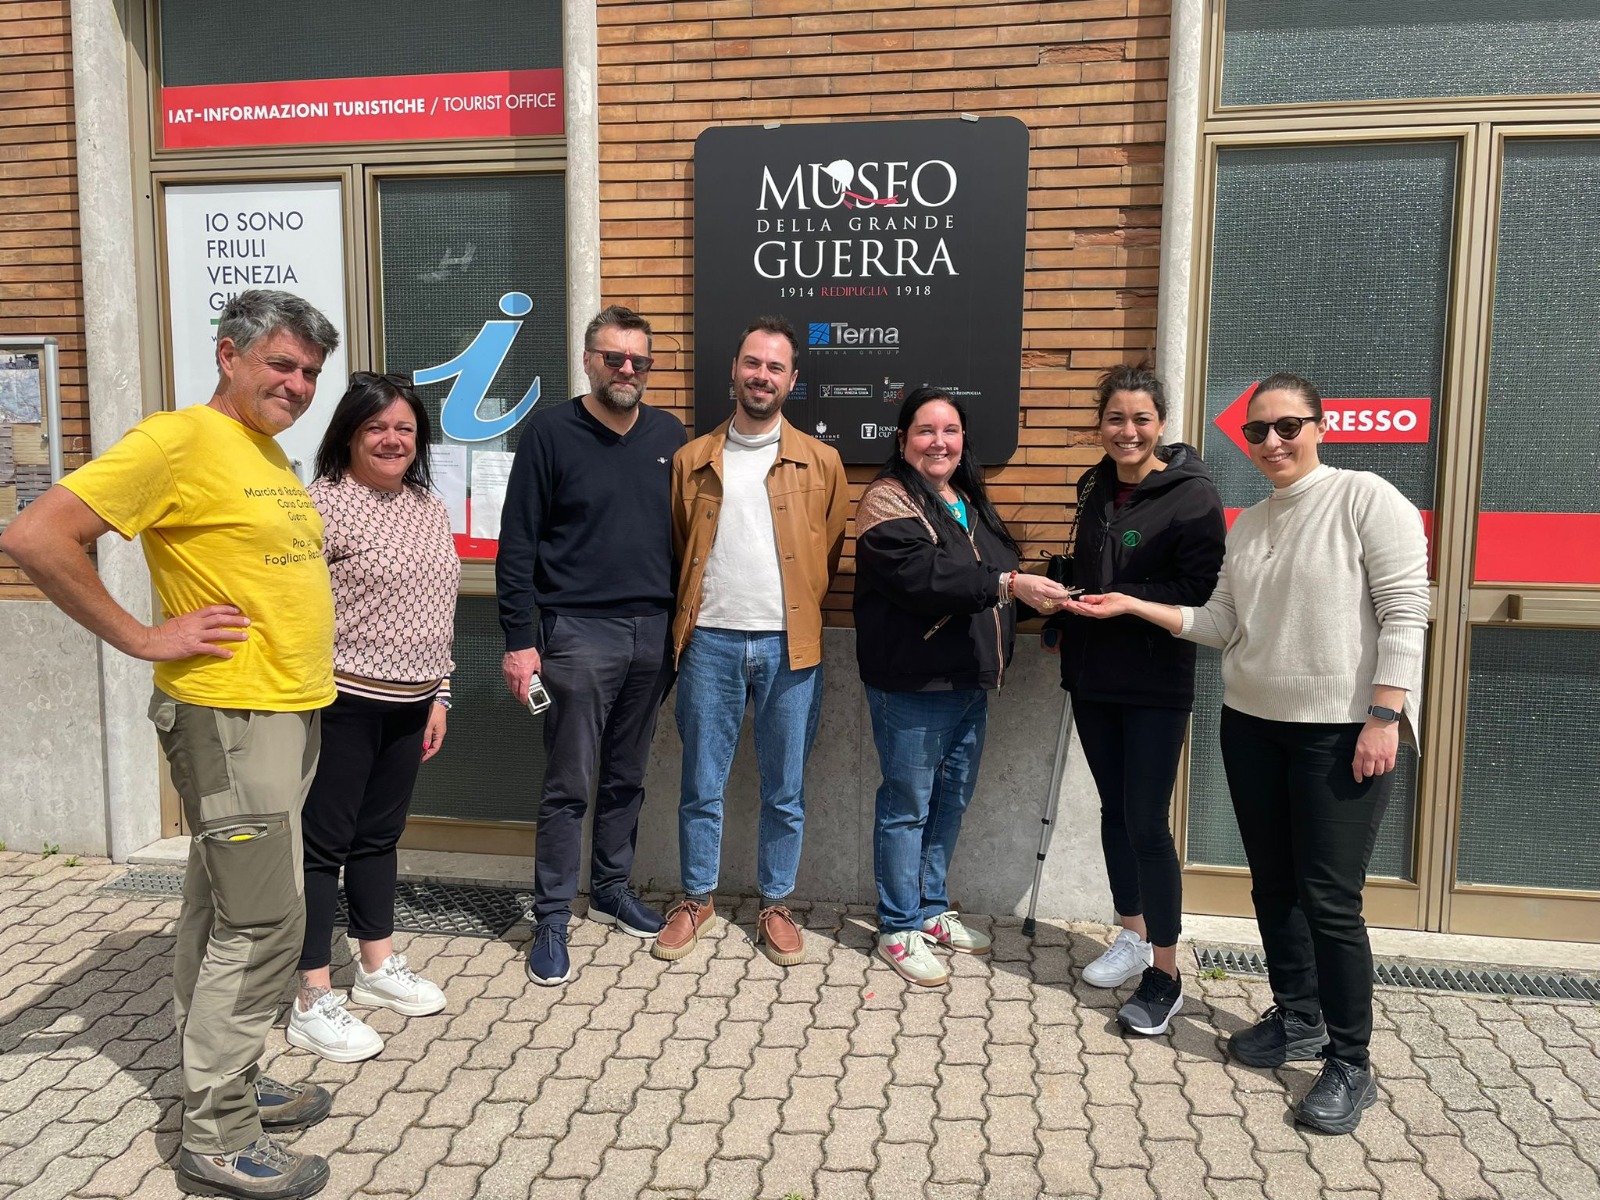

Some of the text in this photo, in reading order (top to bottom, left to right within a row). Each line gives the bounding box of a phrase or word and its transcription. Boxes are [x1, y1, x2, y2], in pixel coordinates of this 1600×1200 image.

[168, 92, 556, 123] IAT-INFORMAZIONI TURISTICHE / TOURIST OFFICE
[756, 159, 958, 211] MUSEO
[205, 211, 304, 232] IO SONO
[756, 215, 955, 233] DELLA GRANDE
[207, 238, 266, 258] FRIULI
[753, 237, 960, 279] GUERRA
[207, 264, 298, 285] VENEZIA
[780, 285, 931, 298] 1914 REDIPUGLIA 1918
[830, 322, 900, 344] Terna
[1325, 409, 1417, 432] RESSO
[243, 487, 277, 498] Marcia
[292, 538, 305, 548] Pro
[264, 552, 307, 566] Fogliano
